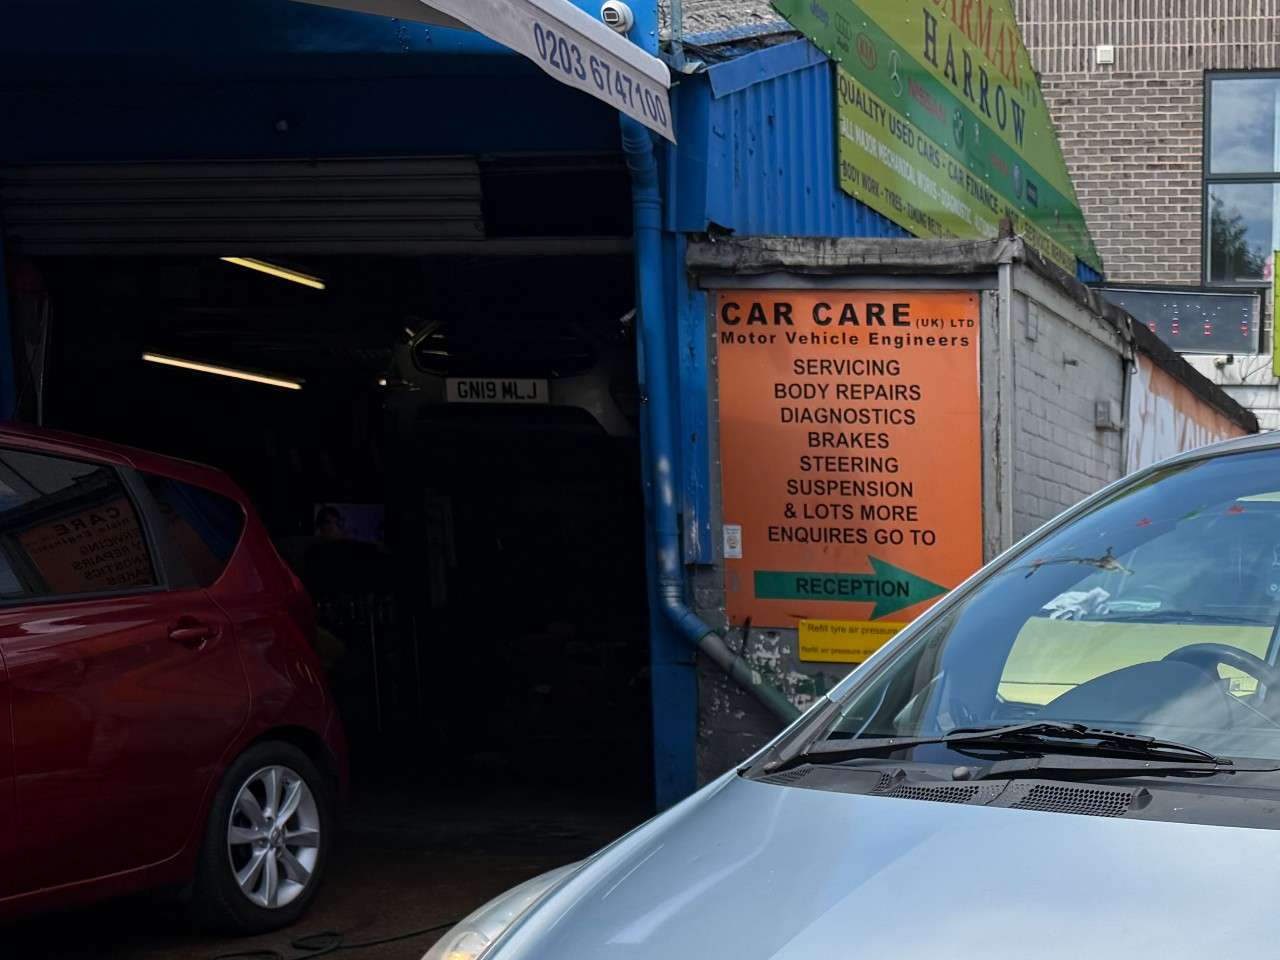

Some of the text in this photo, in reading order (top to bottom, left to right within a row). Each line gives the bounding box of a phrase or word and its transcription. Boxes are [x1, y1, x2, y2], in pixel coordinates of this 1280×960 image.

[932, 0, 1018, 90] RMAX
[534, 22, 667, 127] 0203 6747100
[923, 8, 1025, 148] HARROW
[839, 75, 886, 127] QUALITY
[889, 113, 914, 148] USED
[917, 136, 940, 168] CARS
[721, 302, 974, 329] CAR CARE (UK) LTD
[721, 331, 969, 348] Motor Vehicle Engineers
[793, 359, 900, 376] SERVICING
[457, 381, 537, 399] GN19 MLJ
[774, 383, 921, 400] BODY REPAIRS
[780, 408, 916, 425] DIAGNOSTICS
[808, 432, 889, 449] BRAKES
[800, 456, 899, 473] STEERING
[787, 480, 913, 497] SUSPENSION
[784, 504, 918, 521] & LOTS MORE
[768, 526, 936, 545] ENQUIRES GO TO
[796, 578, 910, 597] RECEPTION
